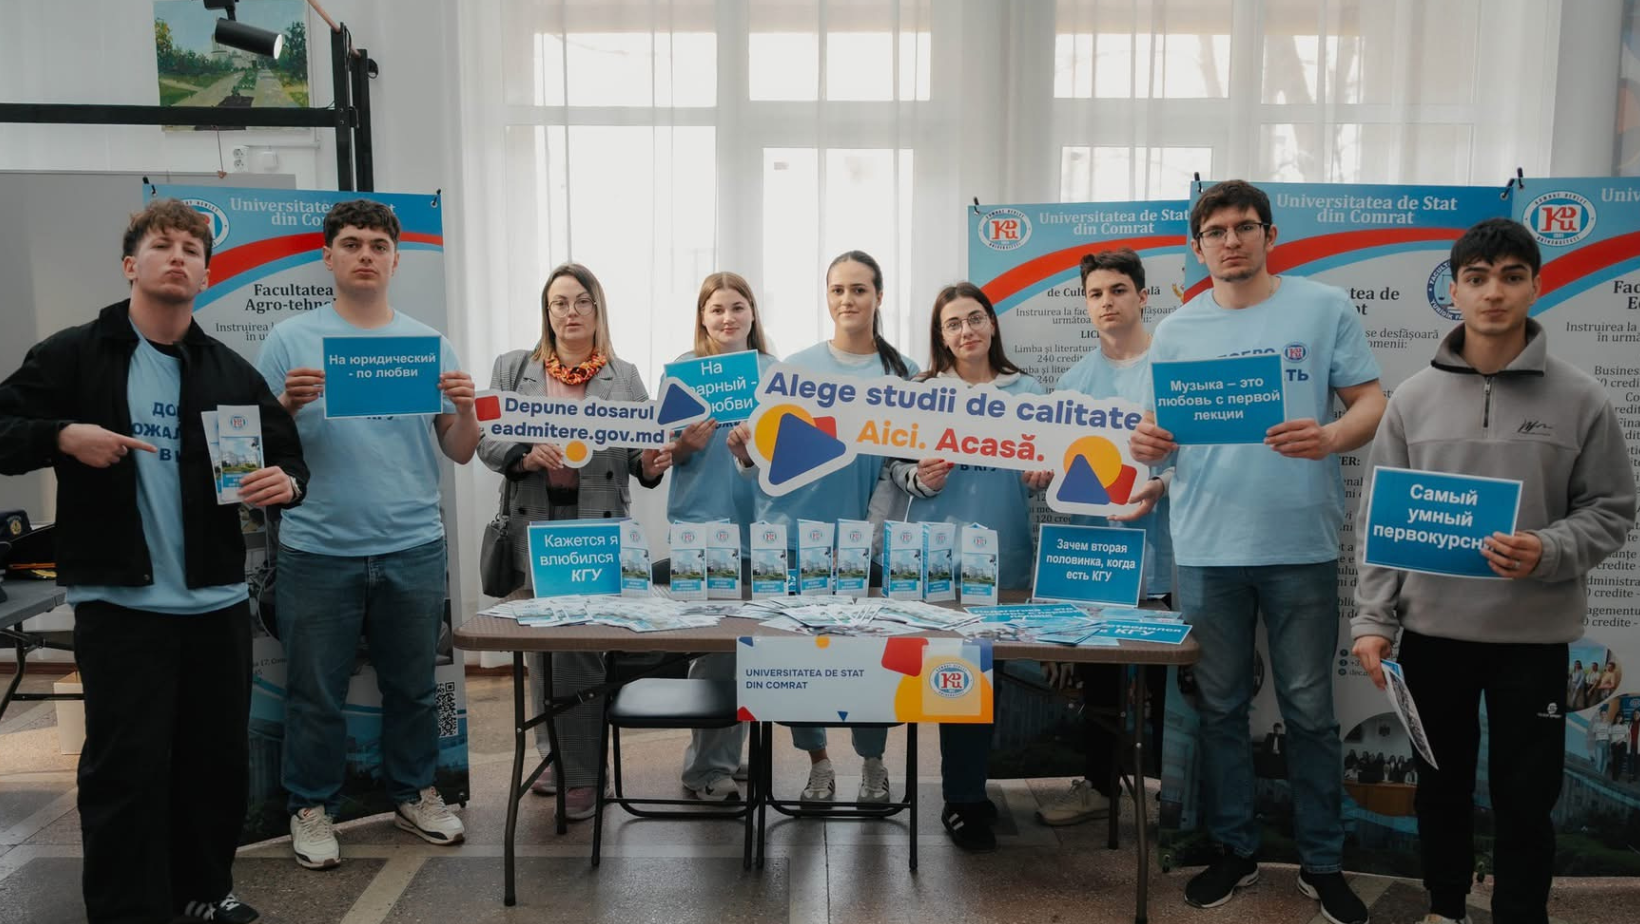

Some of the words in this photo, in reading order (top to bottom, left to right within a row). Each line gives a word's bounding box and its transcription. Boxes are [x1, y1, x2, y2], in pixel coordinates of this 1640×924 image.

[1277, 194, 1392, 210] Universitatea
[1397, 196, 1418, 210] de
[1422, 196, 1458, 210] Stat
[272, 213, 298, 227] din
[1039, 210, 1136, 224] Universitatea
[1140, 209, 1158, 222] de
[1161, 208, 1190, 221] Stat
[1317, 210, 1345, 223] din
[1350, 210, 1414, 224] Comrat
[1073, 224, 1096, 236] din
[1101, 222, 1154, 234] Comrat
[254, 284, 334, 296] Facultatea
[1047, 287, 1060, 298] de
[1380, 287, 1400, 300] de
[245, 298, 337, 314] Agro-tehn
[1016, 308, 1062, 317] Instruirea
[1064, 308, 1072, 316] la
[216, 322, 269, 332] Instruirea
[1052, 316, 1092, 325] următoa
[1566, 322, 1624, 332] Instruirea
[1627, 322, 1638, 332] la
[1365, 330, 1377, 338] se
[1014, 344, 1042, 353] Limba
[1368, 340, 1408, 349] omenii:
[328, 354, 346, 365] На
[350, 352, 436, 366] юридический
[1037, 354, 1055, 363] 240
[356, 370, 372, 378] по
[376, 367, 418, 378] любви
[700, 362, 722, 376] На
[1594, 366, 1640, 376] Busines
[689, 376, 746, 398] арный
[1170, 380, 1224, 394] Музыка
[1240, 377, 1264, 388] это
[711, 397, 754, 413] юбви
[765, 372, 856, 409] Alege
[866, 382, 956, 413] studii
[966, 392, 1006, 418] de
[1016, 400, 1142, 430] calitate
[1158, 394, 1212, 407] любовь
[1216, 396, 1224, 404] с
[1228, 390, 1280, 406] первой
[505, 398, 578, 418] Depune
[584, 404, 654, 420] dosarul
[1194, 410, 1244, 422] лекции
[490, 422, 665, 445] eadmitere.gov.md
[856, 420, 926, 450] Aici.
[935, 427, 1044, 462] Acasă.
[1410, 484, 1478, 506] Самый
[1407, 508, 1474, 528] умный
[544, 534, 606, 548] Кажется
[610, 534, 618, 546] я
[1373, 524, 1494, 550] первокурсн
[1056, 538, 1088, 551] Зачем
[1091, 543, 1128, 554] вторая
[540, 552, 614, 566] влюбился
[1046, 554, 1104, 568] половинка,
[1106, 558, 1136, 570] когда
[1596, 561, 1636, 571] credite
[571, 568, 603, 582] КГУ
[1066, 570, 1090, 581] есть
[1092, 570, 1112, 582] КГУ
[1594, 588, 1634, 598] credite
[1592, 618, 1631, 628] credite
[1114, 628, 1155, 636] КГУ
[746, 668, 822, 678] UNIVERSITATEA
[824, 669, 838, 678] DE
[840, 669, 864, 678] STAT
[746, 681, 764, 690] DIN
[765, 681, 808, 690] COMRAT
